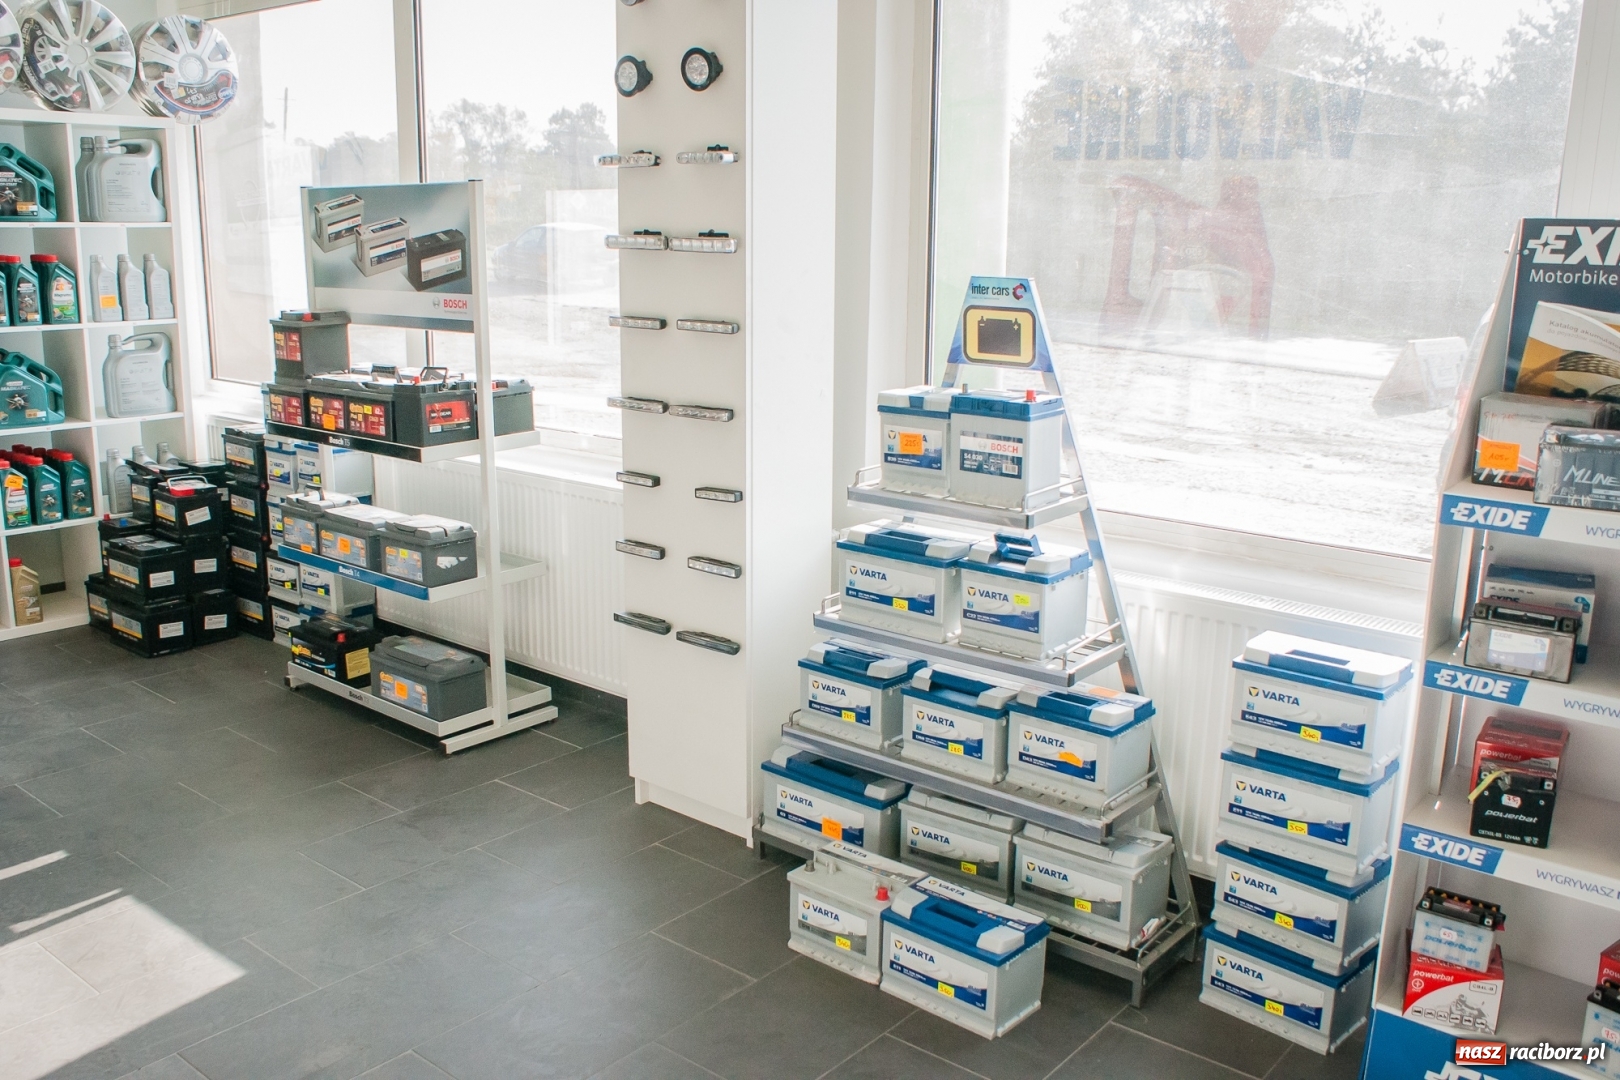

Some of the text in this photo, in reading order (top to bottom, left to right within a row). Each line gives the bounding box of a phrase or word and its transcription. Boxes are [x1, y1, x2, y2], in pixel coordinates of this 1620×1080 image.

[1526, 225, 1620, 266] EXI
[1529, 268, 1618, 286] Motorbike
[971, 283, 1010, 297] inter cars
[443, 298, 468, 310] BOSCH
[1549, 319, 1620, 350] Katalog akumulato
[328, 435, 344, 445] Bosch
[990, 442, 1019, 454] BOSCH
[1479, 467, 1535, 487] M.LIN
[1450, 502, 1620, 539] EXIDE WYGR
[338, 565, 354, 576] Bosch
[859, 567, 888, 581] VARTA
[978, 589, 1009, 603] VARTA
[349, 690, 364, 702] Bosch
[820, 683, 847, 697] VARTA
[1262, 689, 1300, 706] VARTA
[1434, 668, 1620, 718] EXIDE WYGRYW
[926, 713, 955, 728] VARTA
[1034, 733, 1065, 749] VARTA
[1480, 748, 1522, 761] powerbat
[1249, 783, 1287, 802] VARTA
[788, 793, 814, 808] VARTA
[1484, 809, 1539, 823] powerbat
[921, 829, 950, 845] VARTA
[842, 846, 868, 858] VARTA
[1411, 832, 1614, 899] EXIDE WYGRYWASZ
[1037, 865, 1069, 882] VARTA
[938, 882, 966, 897] VARTA
[1243, 875, 1278, 896] VARTA
[811, 904, 840, 922] VARTA
[1423, 934, 1479, 954] powerbat
[904, 944, 935, 964] VARTA
[1229, 960, 1264, 981] VARTA
[1412, 969, 1455, 983] powerbat
[1602, 967, 1620, 979] pow
